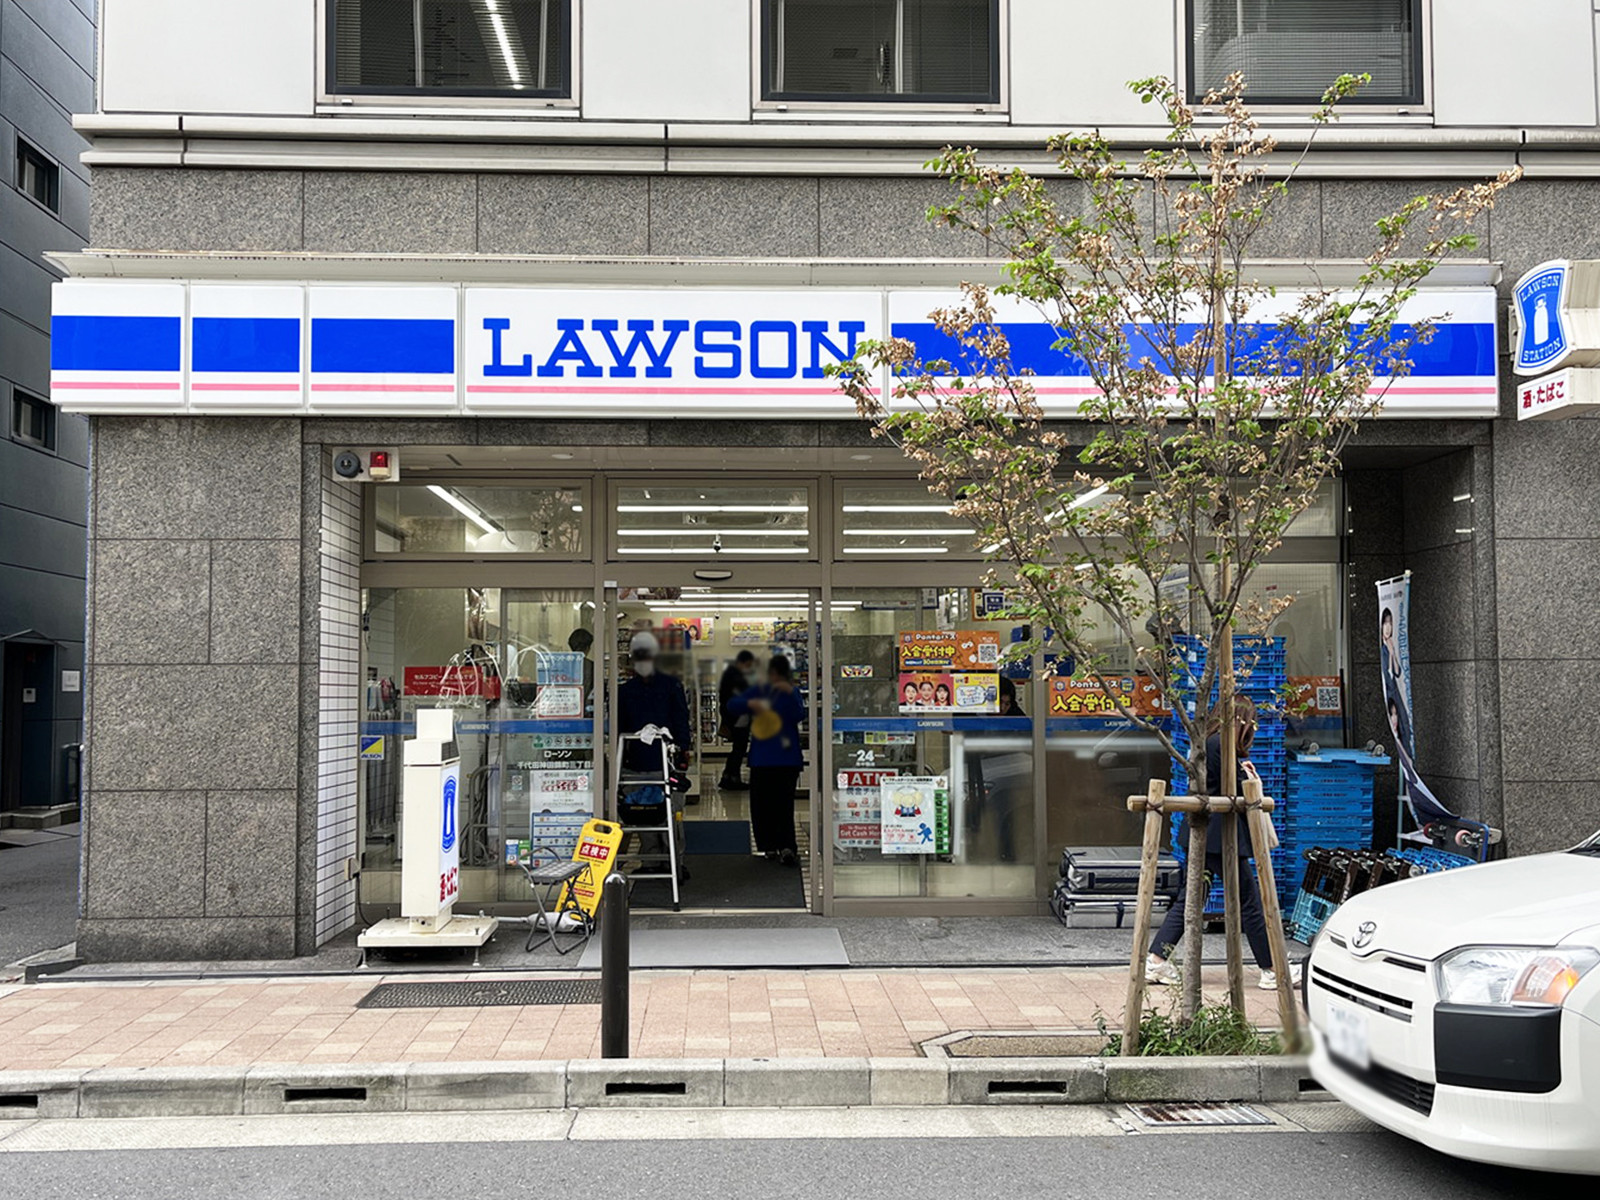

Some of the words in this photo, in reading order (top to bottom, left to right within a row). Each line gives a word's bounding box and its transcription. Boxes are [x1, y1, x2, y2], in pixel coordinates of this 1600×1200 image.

[1520, 274, 1560, 302] LAWSON
[482, 318, 866, 379] LAWSON
[1523, 337, 1562, 361] STATION
[1522, 380, 1565, 409] 酒・たばこ
[902, 645, 956, 657] 入会受付中
[1053, 693, 1131, 711] 入会受付中
[544, 750, 572, 758] ローソン
[857, 749, 875, 762] 24
[580, 844, 609, 859] 点検中
